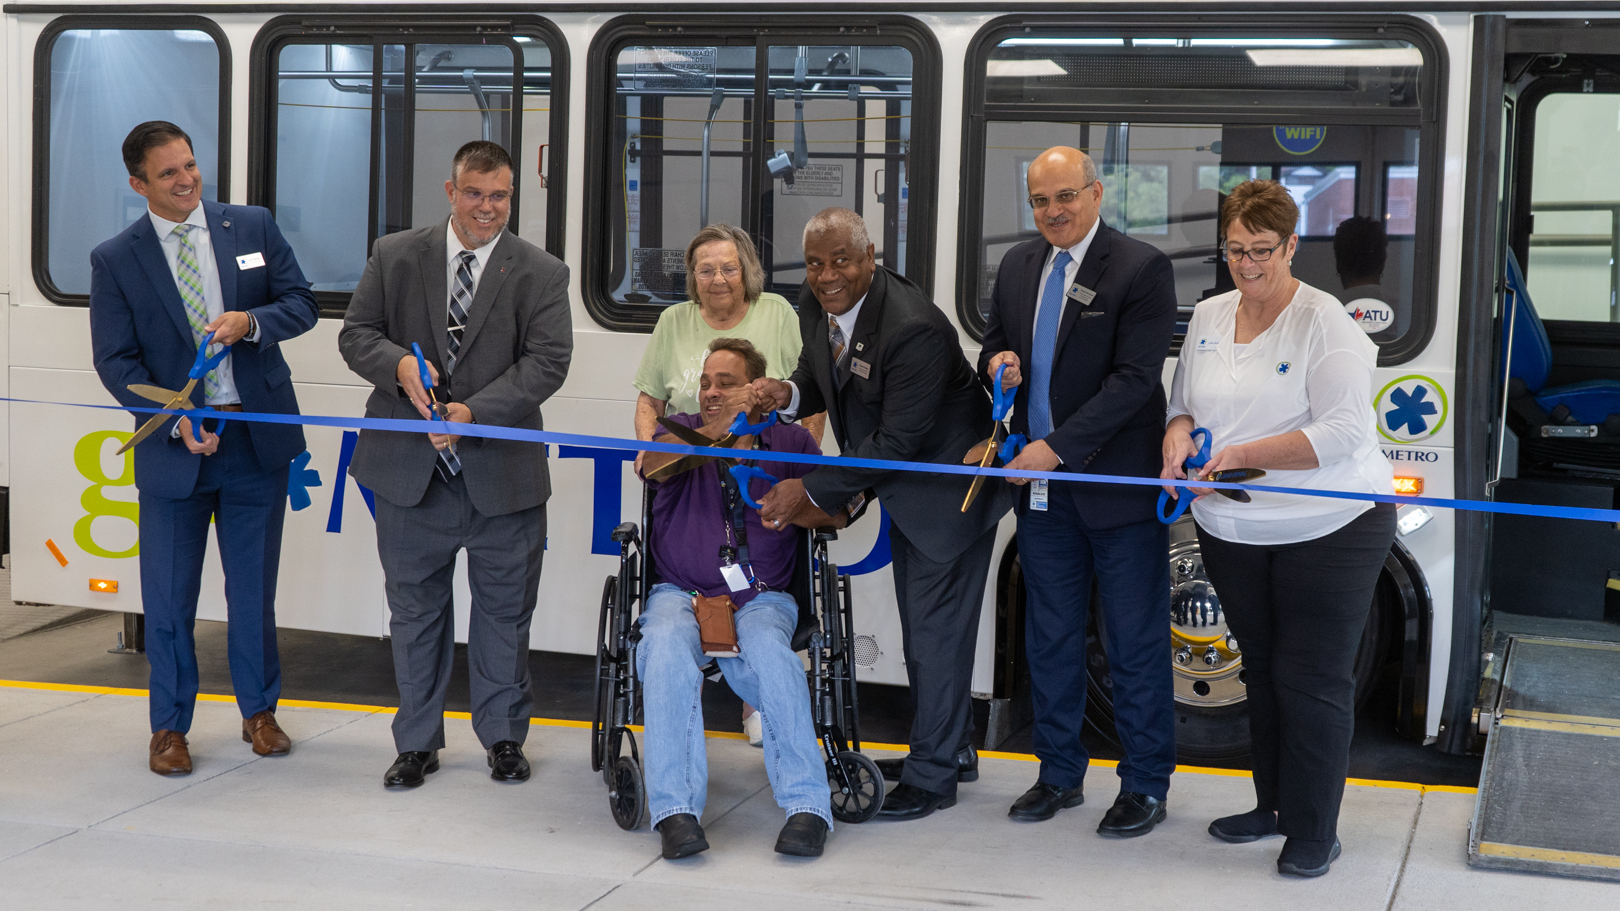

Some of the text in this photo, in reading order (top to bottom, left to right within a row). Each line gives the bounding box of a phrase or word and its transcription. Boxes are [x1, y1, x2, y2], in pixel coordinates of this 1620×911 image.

[1286, 127, 1320, 139] WIFI
[1363, 309, 1389, 321] ATU
[1381, 449, 1439, 463] METRO
[824, 733, 835, 757] Cruiser
